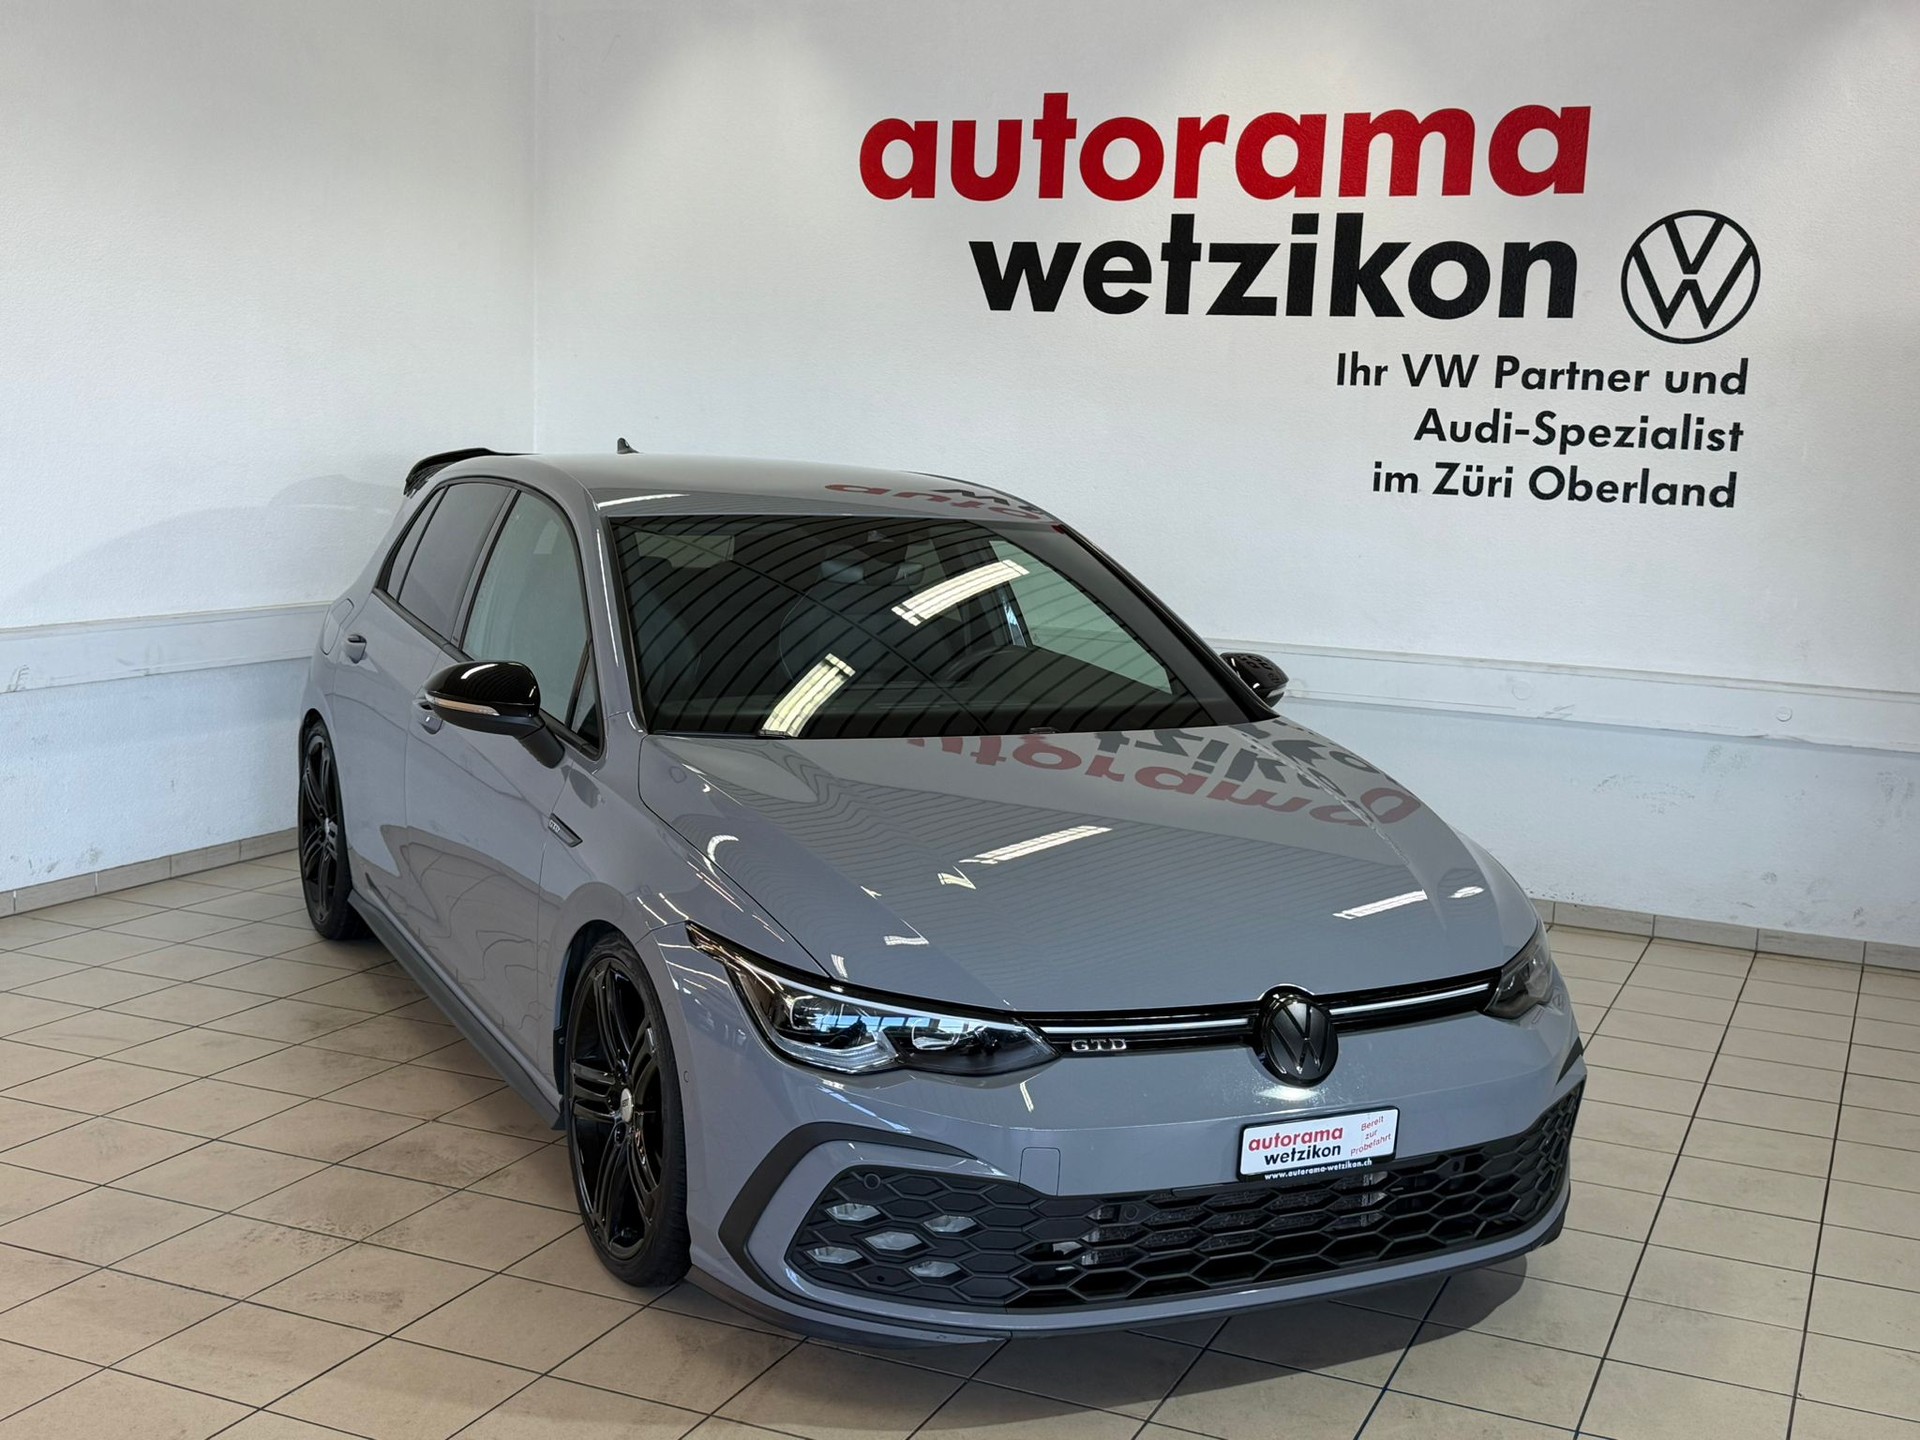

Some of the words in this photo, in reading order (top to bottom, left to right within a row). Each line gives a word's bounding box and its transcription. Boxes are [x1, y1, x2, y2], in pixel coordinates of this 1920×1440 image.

[860, 93, 1591, 201] autorama
[969, 213, 1577, 319] wetzikon
[1622, 210, 1760, 344] VW
[1336, 351, 1388, 386] Ihr
[1402, 354, 1479, 388] VW
[1495, 355, 1649, 393] Partner
[1665, 358, 1748, 395] und
[1414, 408, 1744, 454] Audi-Spezialist
[1372, 461, 1419, 494] im
[1433, 461, 1513, 498] Züri
[1528, 466, 1737, 508] Oberland
[1071, 1038, 1127, 1052] GTD
[1361, 1115, 1384, 1132] Bereit
[1365, 1129, 1378, 1140] zur
[1248, 1127, 1344, 1151] autorama
[1350, 1133, 1392, 1157] Probefahrt
[1264, 1145, 1342, 1166] wetzikon
[1264, 1158, 1373, 1180] www.autorama-wetzikon.ch
